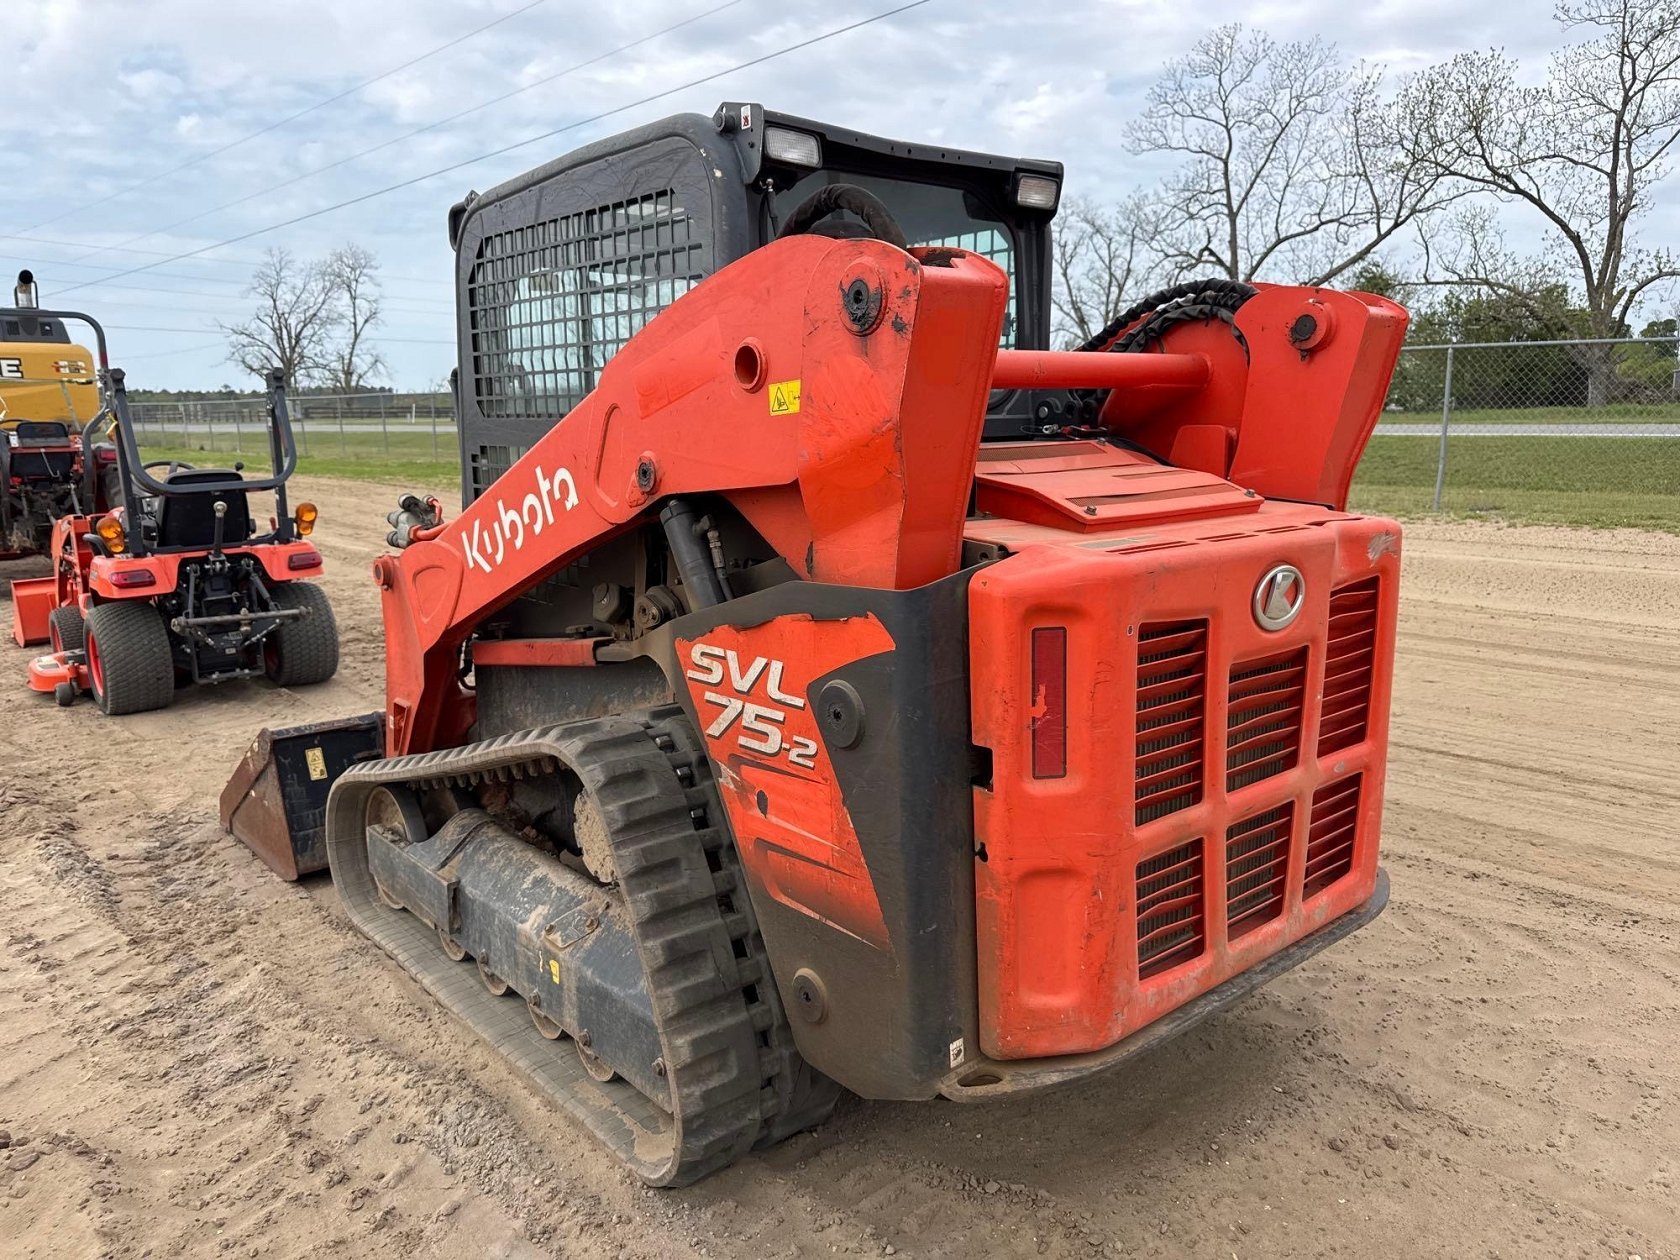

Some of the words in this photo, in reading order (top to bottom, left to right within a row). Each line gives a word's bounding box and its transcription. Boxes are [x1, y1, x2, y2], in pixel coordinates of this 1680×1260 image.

[461, 465, 579, 573] Kubota
[687, 643, 805, 708] SVL
[704, 691, 818, 768] 75-2
